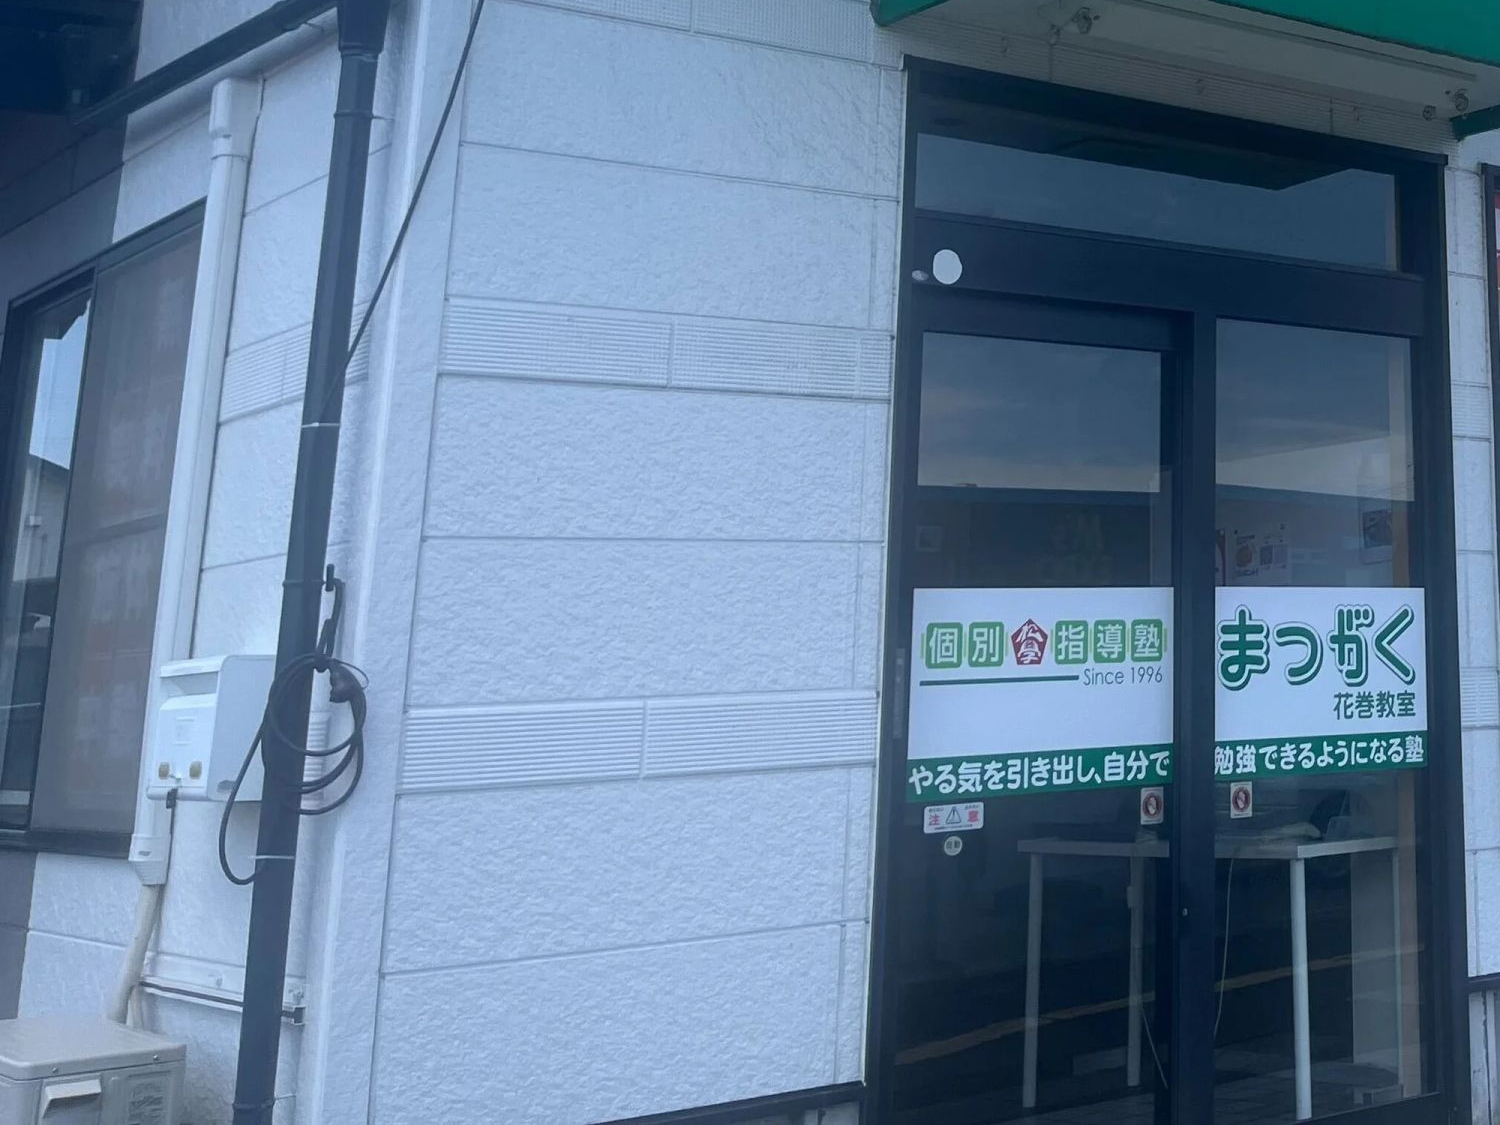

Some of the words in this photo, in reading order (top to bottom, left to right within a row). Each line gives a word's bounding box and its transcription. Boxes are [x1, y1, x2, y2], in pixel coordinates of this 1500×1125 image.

[929, 626, 999, 664] 個別
[1057, 623, 1161, 661] 指導塾
[1217, 603, 1416, 691] まつがく
[1082, 666, 1125, 687] Since
[1130, 666, 1163, 685] 1996
[1333, 690, 1416, 721] 花巻教室
[908, 749, 1170, 796] やる気を引き出し、自分で
[1214, 735, 1424, 775] 勉強できるようになる塾
